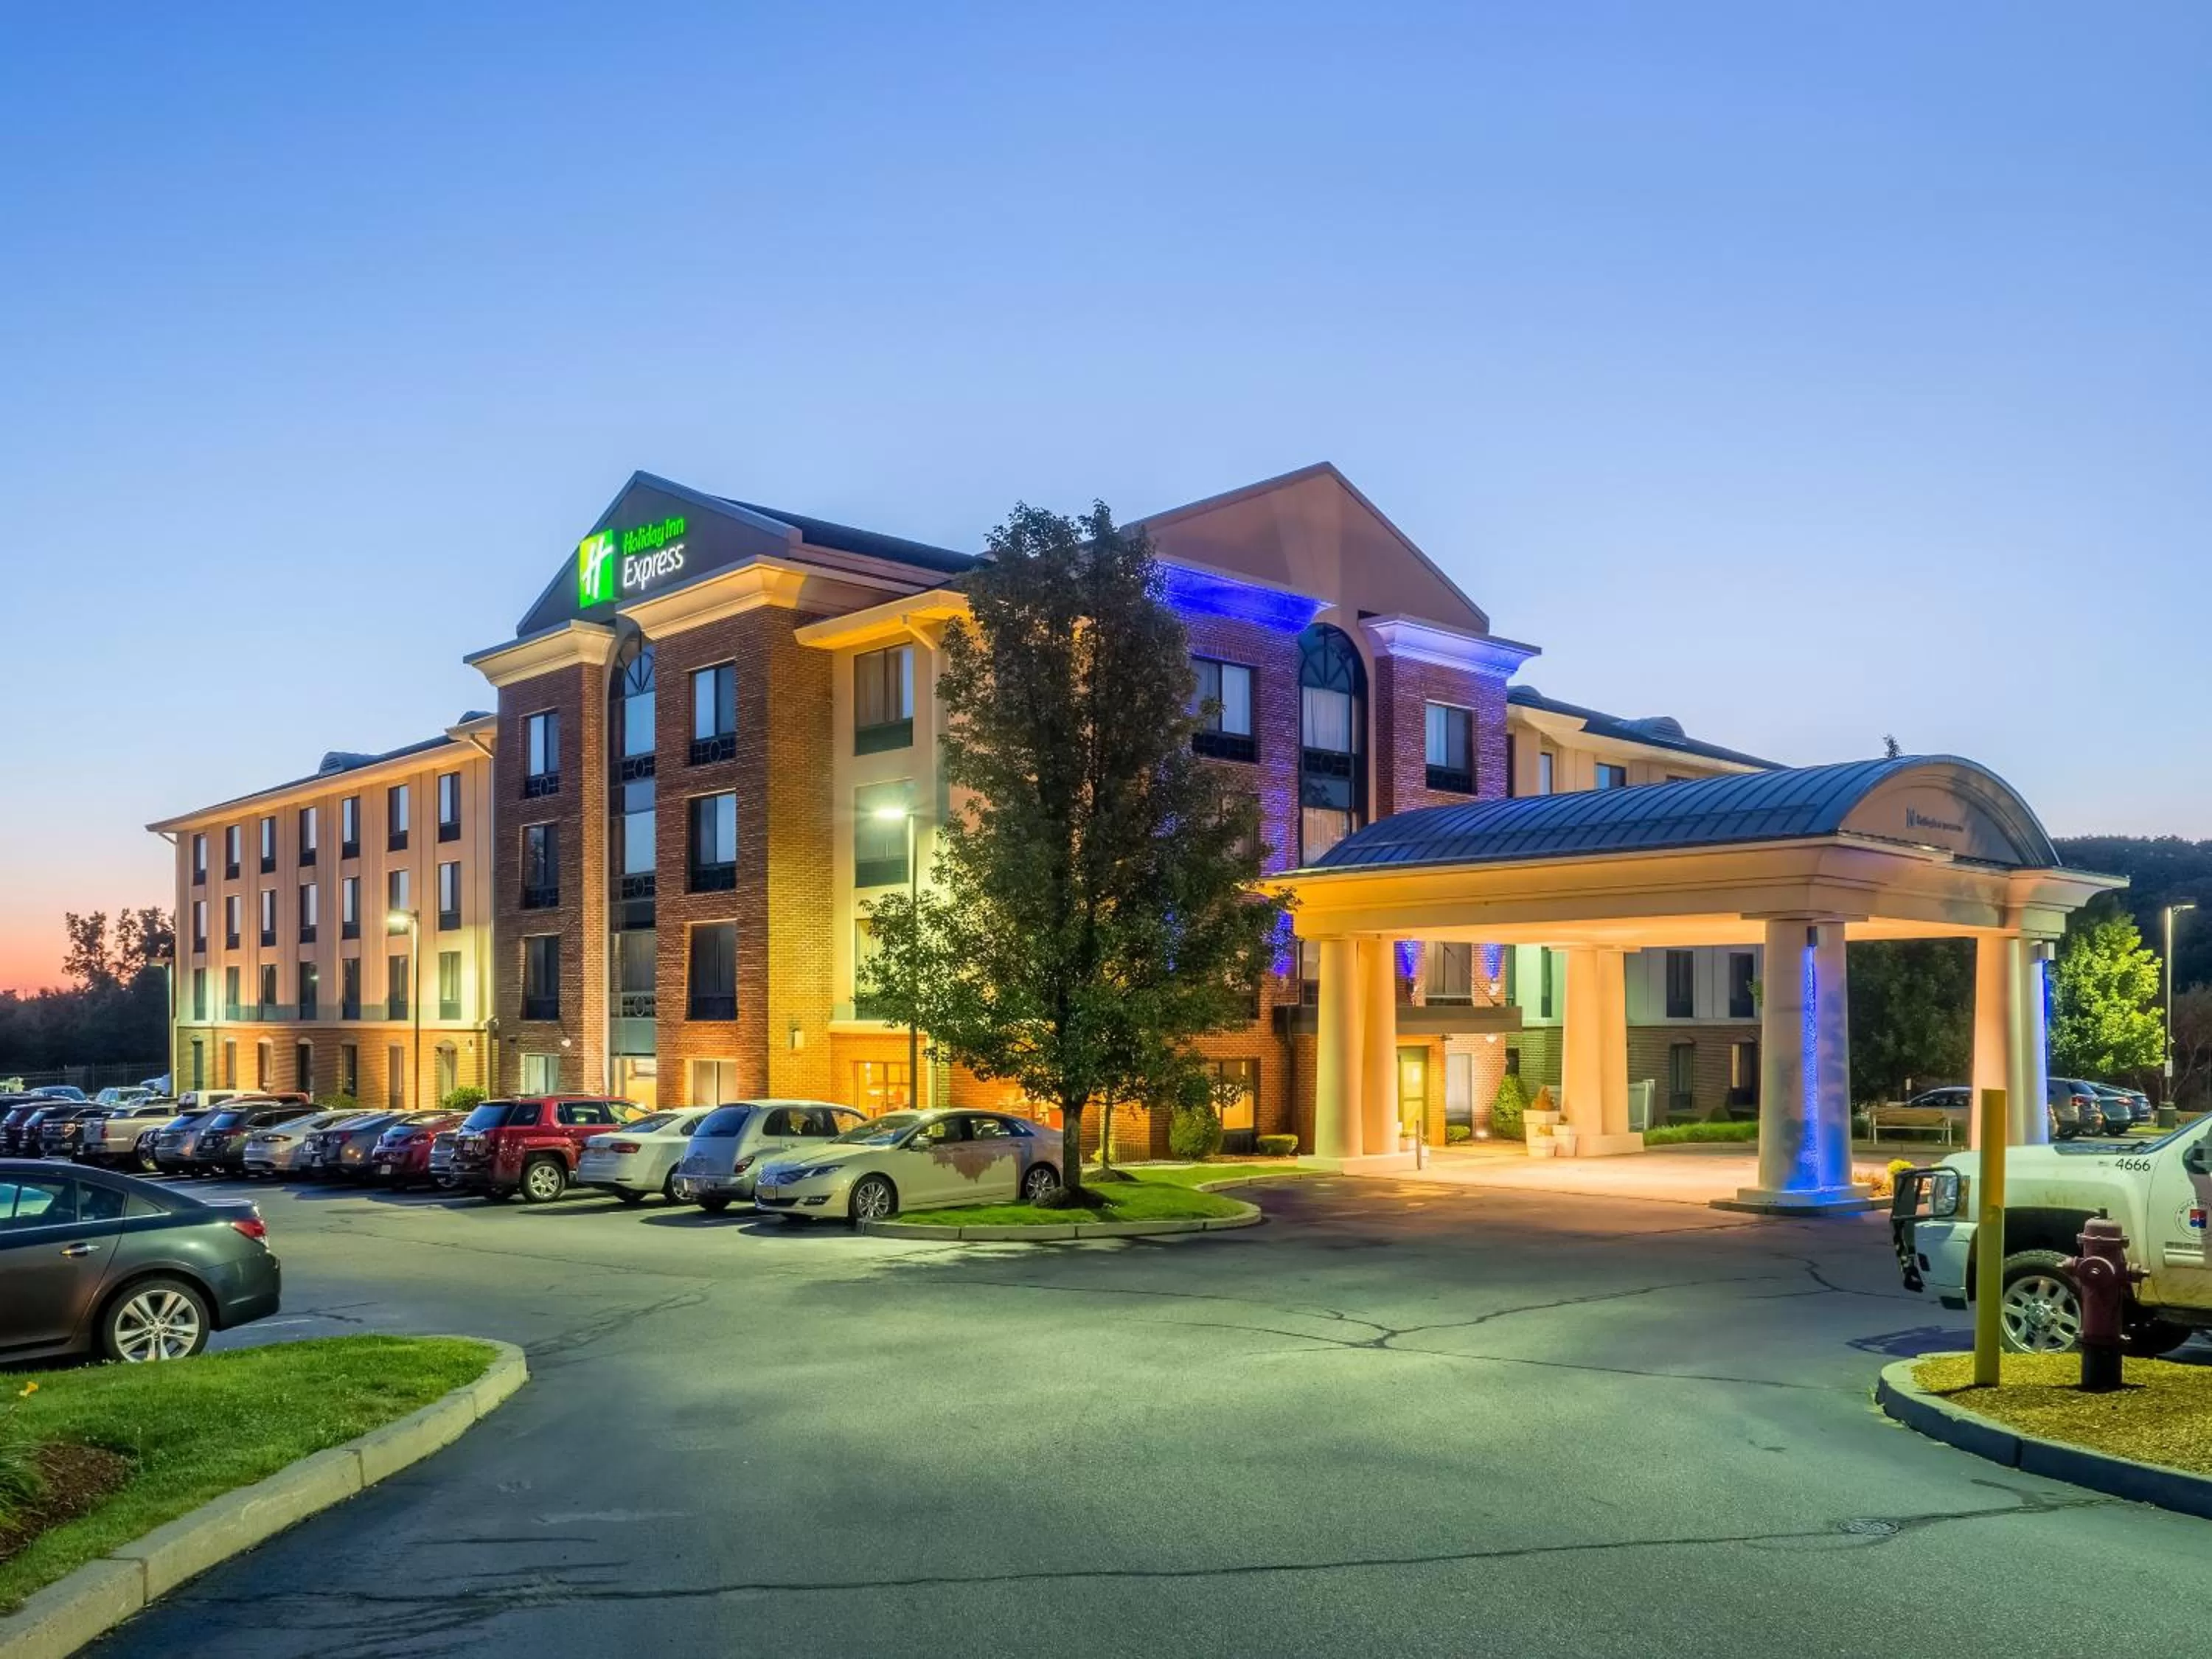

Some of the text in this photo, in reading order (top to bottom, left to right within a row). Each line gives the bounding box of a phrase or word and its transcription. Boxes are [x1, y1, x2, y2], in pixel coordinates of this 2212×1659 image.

[623, 517, 685, 554] Holiday Inn
[622, 543, 685, 591] Express
[2115, 1158, 2151, 1172] 4666
